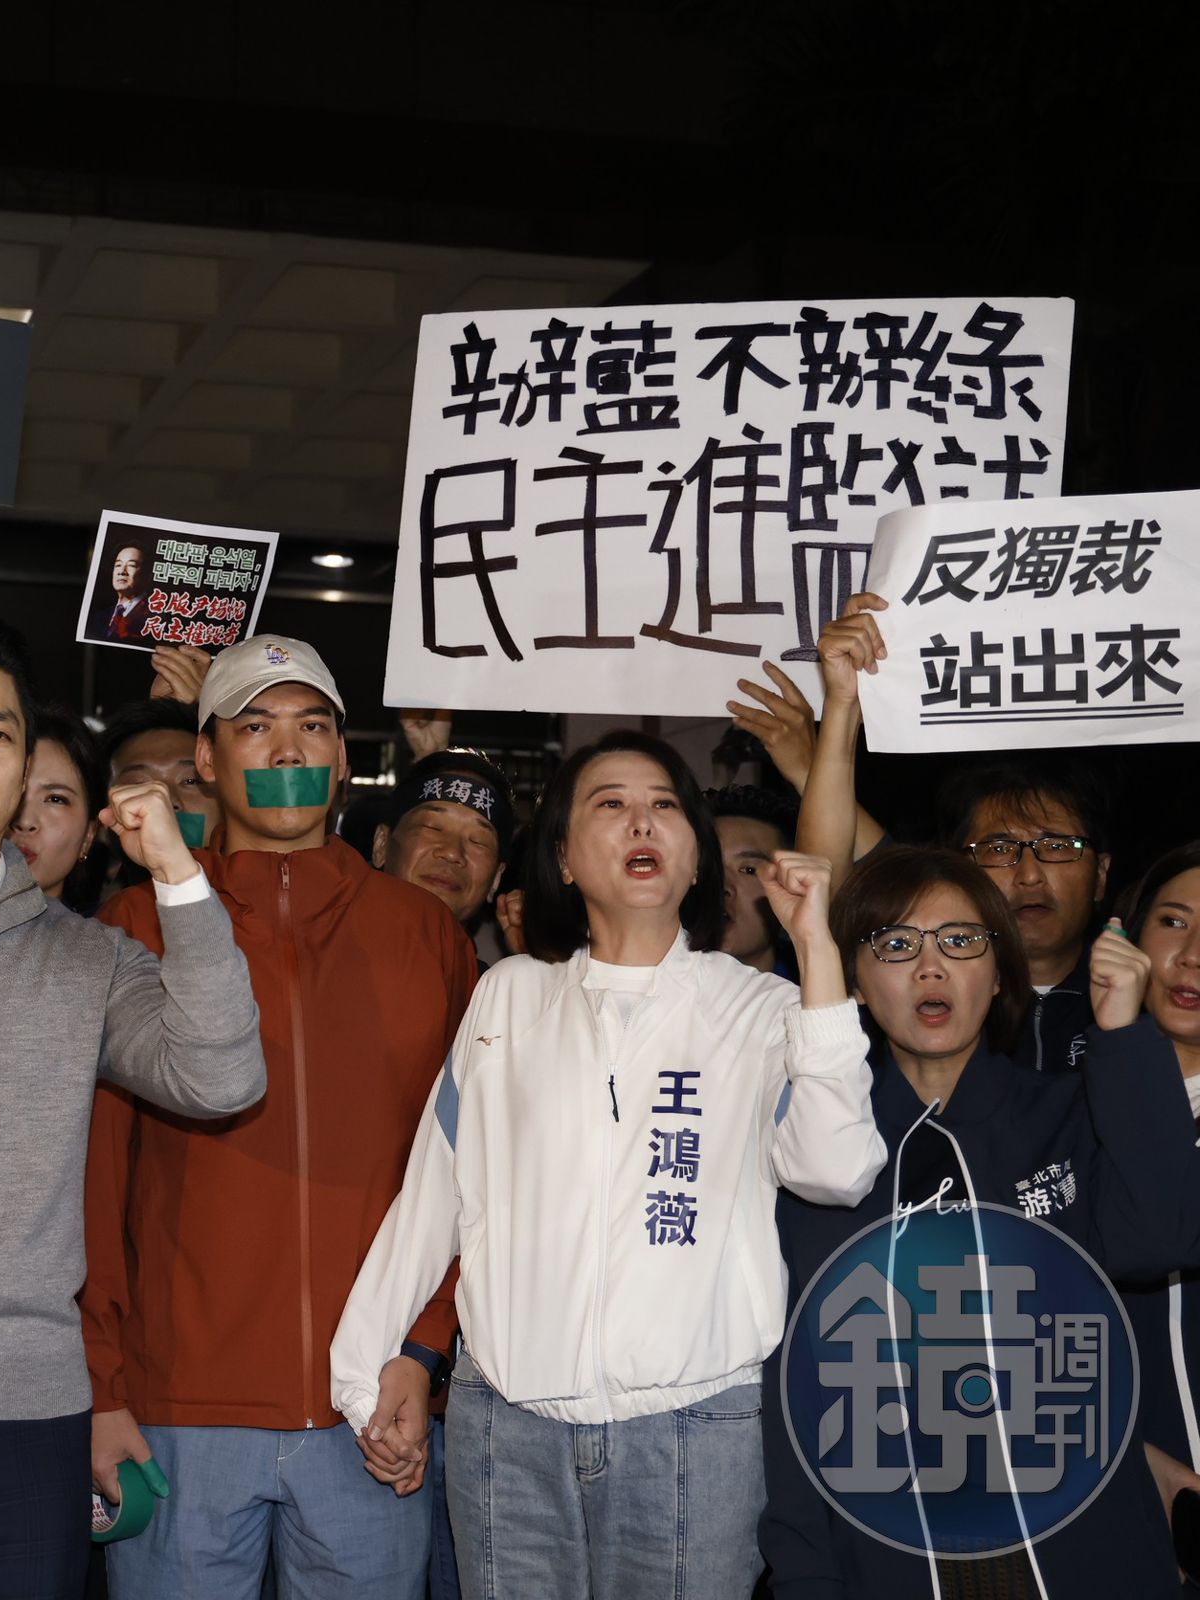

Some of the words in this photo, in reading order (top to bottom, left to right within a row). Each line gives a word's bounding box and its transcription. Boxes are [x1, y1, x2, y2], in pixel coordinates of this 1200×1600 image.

[152, 561, 204, 589] 민주의
[155, 539, 209, 566] 대만판
[901, 518, 1163, 607] 反獨裁
[919, 623, 1184, 709] 站出來
[644, 1070, 703, 1247] 王鴻薇
